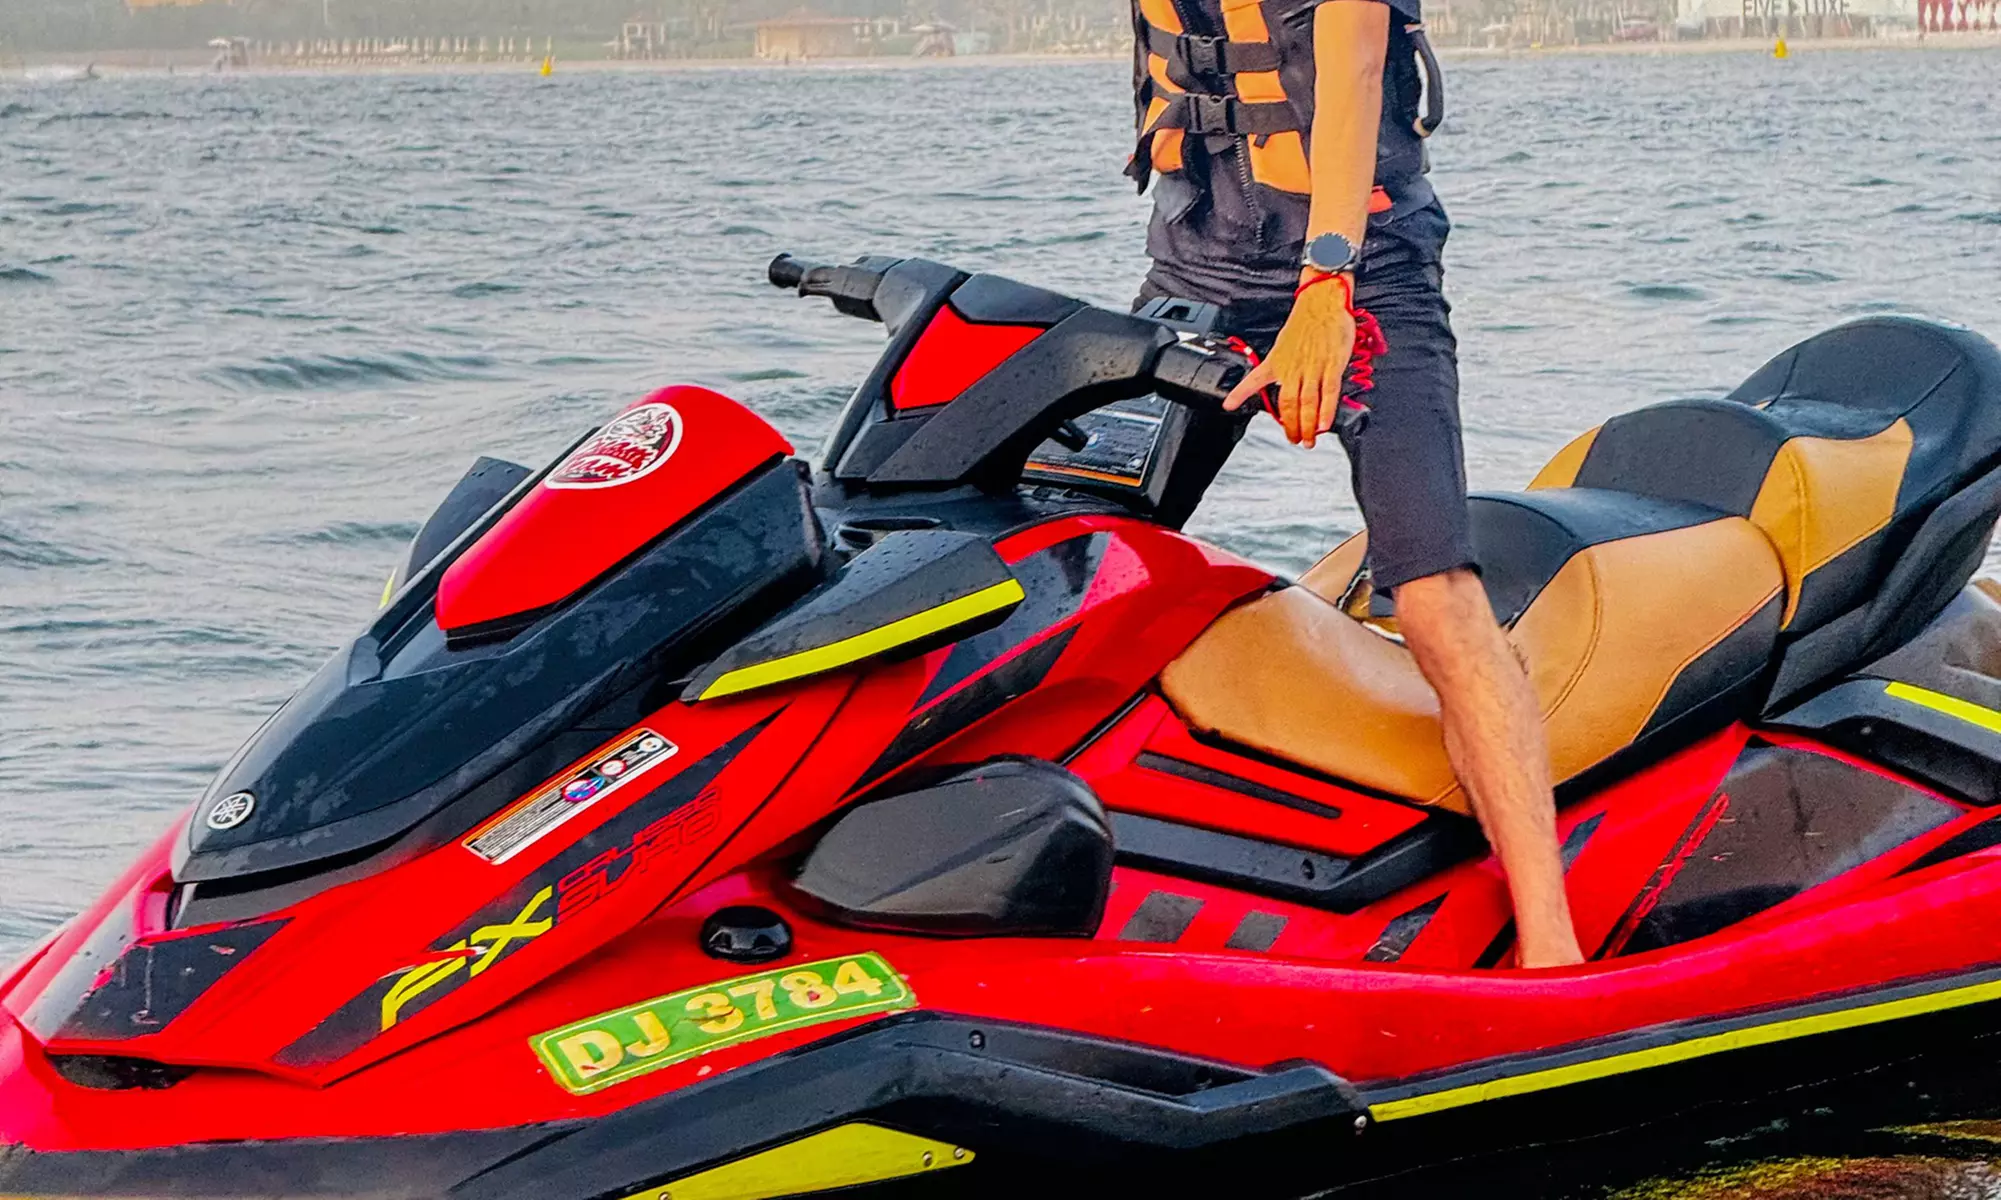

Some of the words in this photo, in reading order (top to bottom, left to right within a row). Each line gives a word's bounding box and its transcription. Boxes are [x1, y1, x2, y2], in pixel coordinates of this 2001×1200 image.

[381, 885, 553, 1032] FX
[557, 1011, 671, 1080] DJ
[684, 960, 883, 1035] 3784
